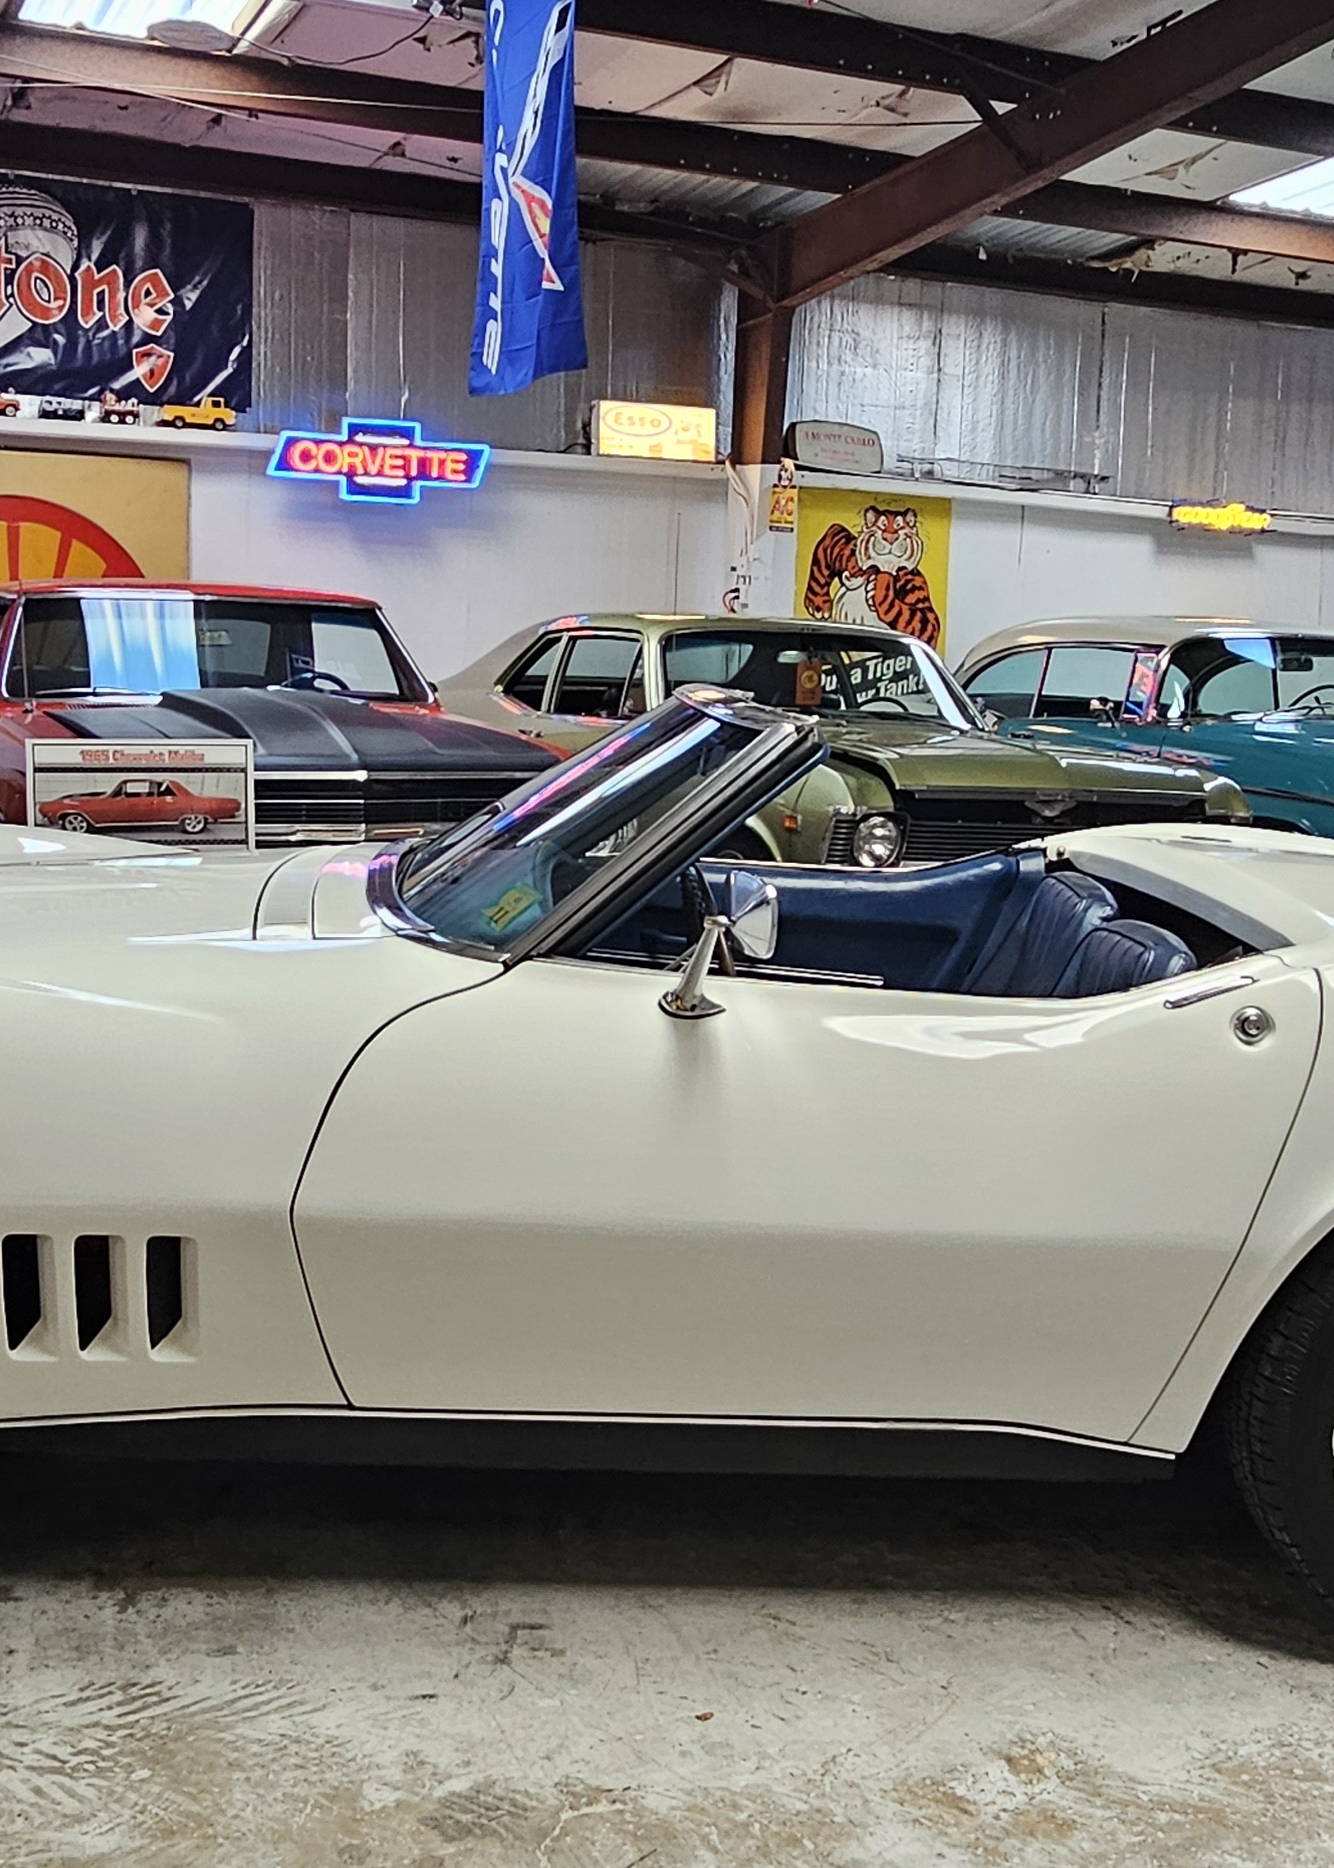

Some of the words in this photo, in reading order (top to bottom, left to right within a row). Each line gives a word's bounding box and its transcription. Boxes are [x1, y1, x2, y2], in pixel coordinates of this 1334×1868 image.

[481, 0, 509, 375] CVETTE
[287, 439, 469, 481] CORVETTE
[850, 668, 863, 685] a
[867, 655, 913, 681] Tiger
